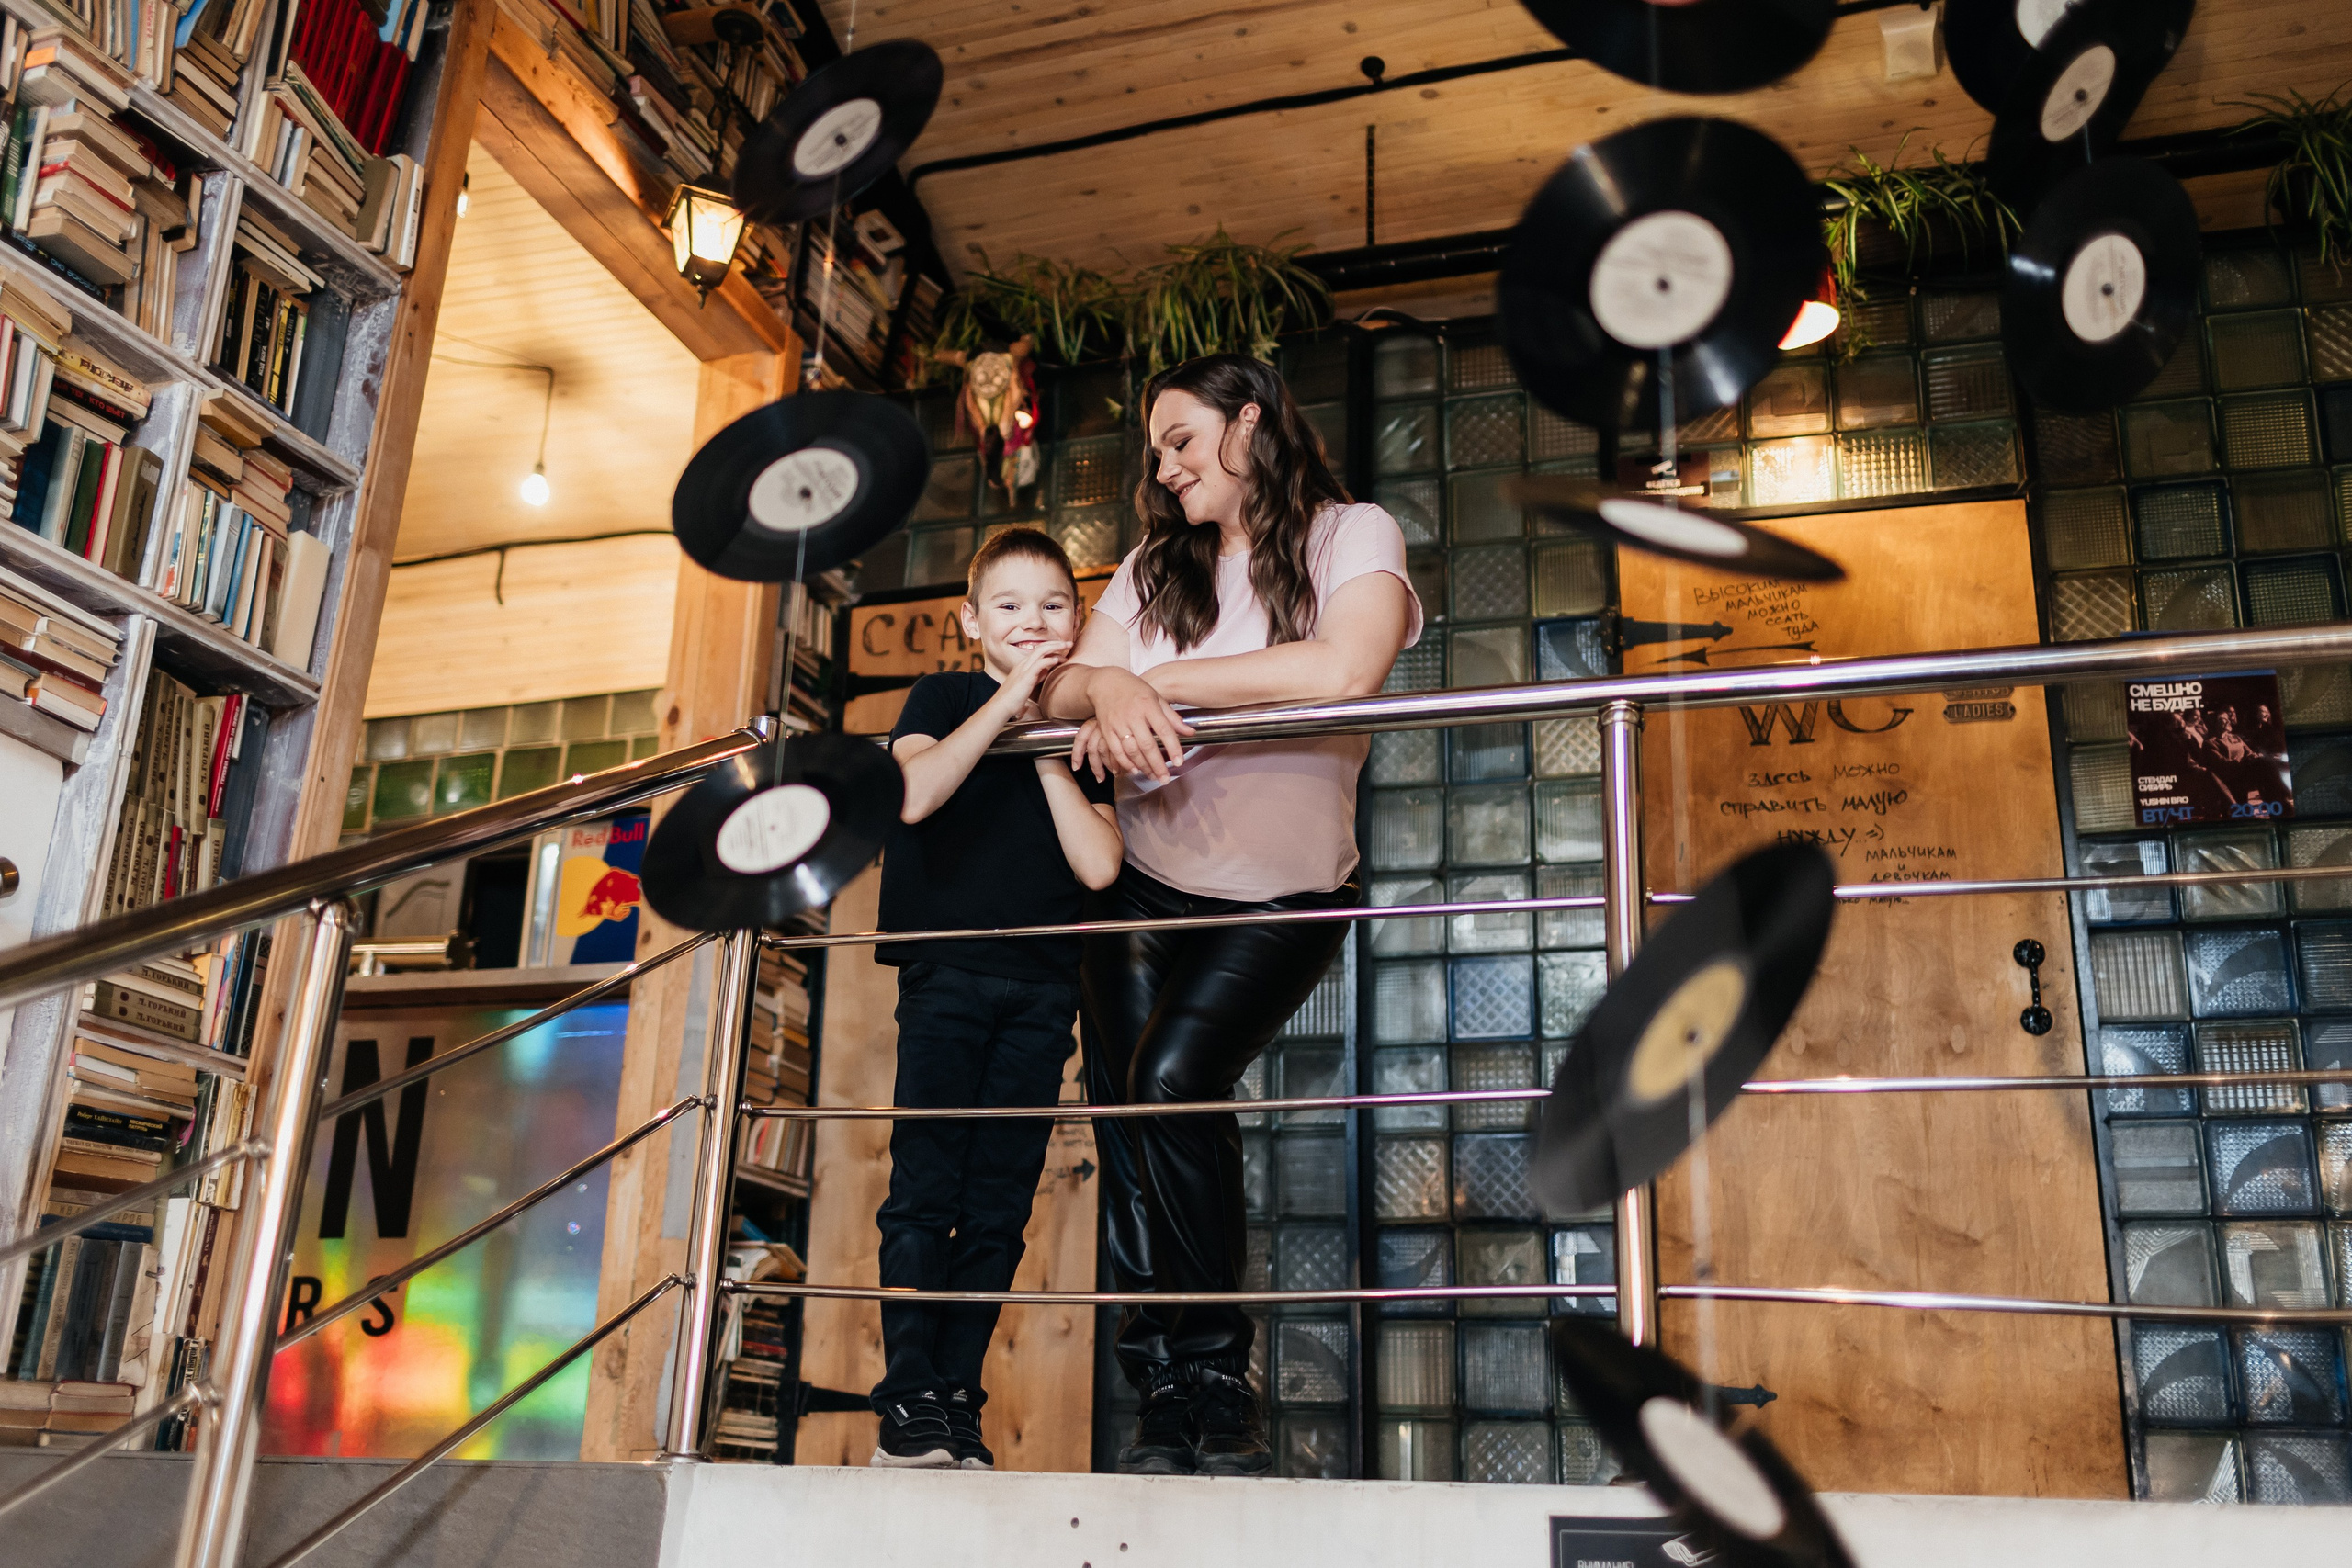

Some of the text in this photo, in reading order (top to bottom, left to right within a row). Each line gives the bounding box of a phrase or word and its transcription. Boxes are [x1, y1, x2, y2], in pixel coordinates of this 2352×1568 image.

[89, 396, 105, 410] КТО
[1694, 578, 1780, 606] ВЫСОКИМ
[1725, 583, 1808, 612] МАЛЬЧИКАМ
[1747, 599, 1801, 620] МОЖНО
[1765, 611, 1809, 626] ССАТЬ
[1781, 620, 1819, 641] ТУДА
[2129, 682, 2203, 698] СМЕШНО
[1953, 703, 2005, 718] LADIES
[2131, 695, 2205, 713] НЕ БУДЕТ.
[1833, 762, 1900, 779] МОЖНО
[2138, 774, 2177, 785] СТЕНДАП
[1720, 789, 1908, 819] СПРАВИТЬ МАЛУЮ
[2170, 795, 2189, 805] BRO
[571, 822, 646, 849] Red Bull
[1865, 845, 1957, 862] МАЛЬЧИКАМ
[147, 1000, 187, 1019] ГОРЬКИЙ
[145, 1015, 186, 1034] ГОРЬКИЙ
